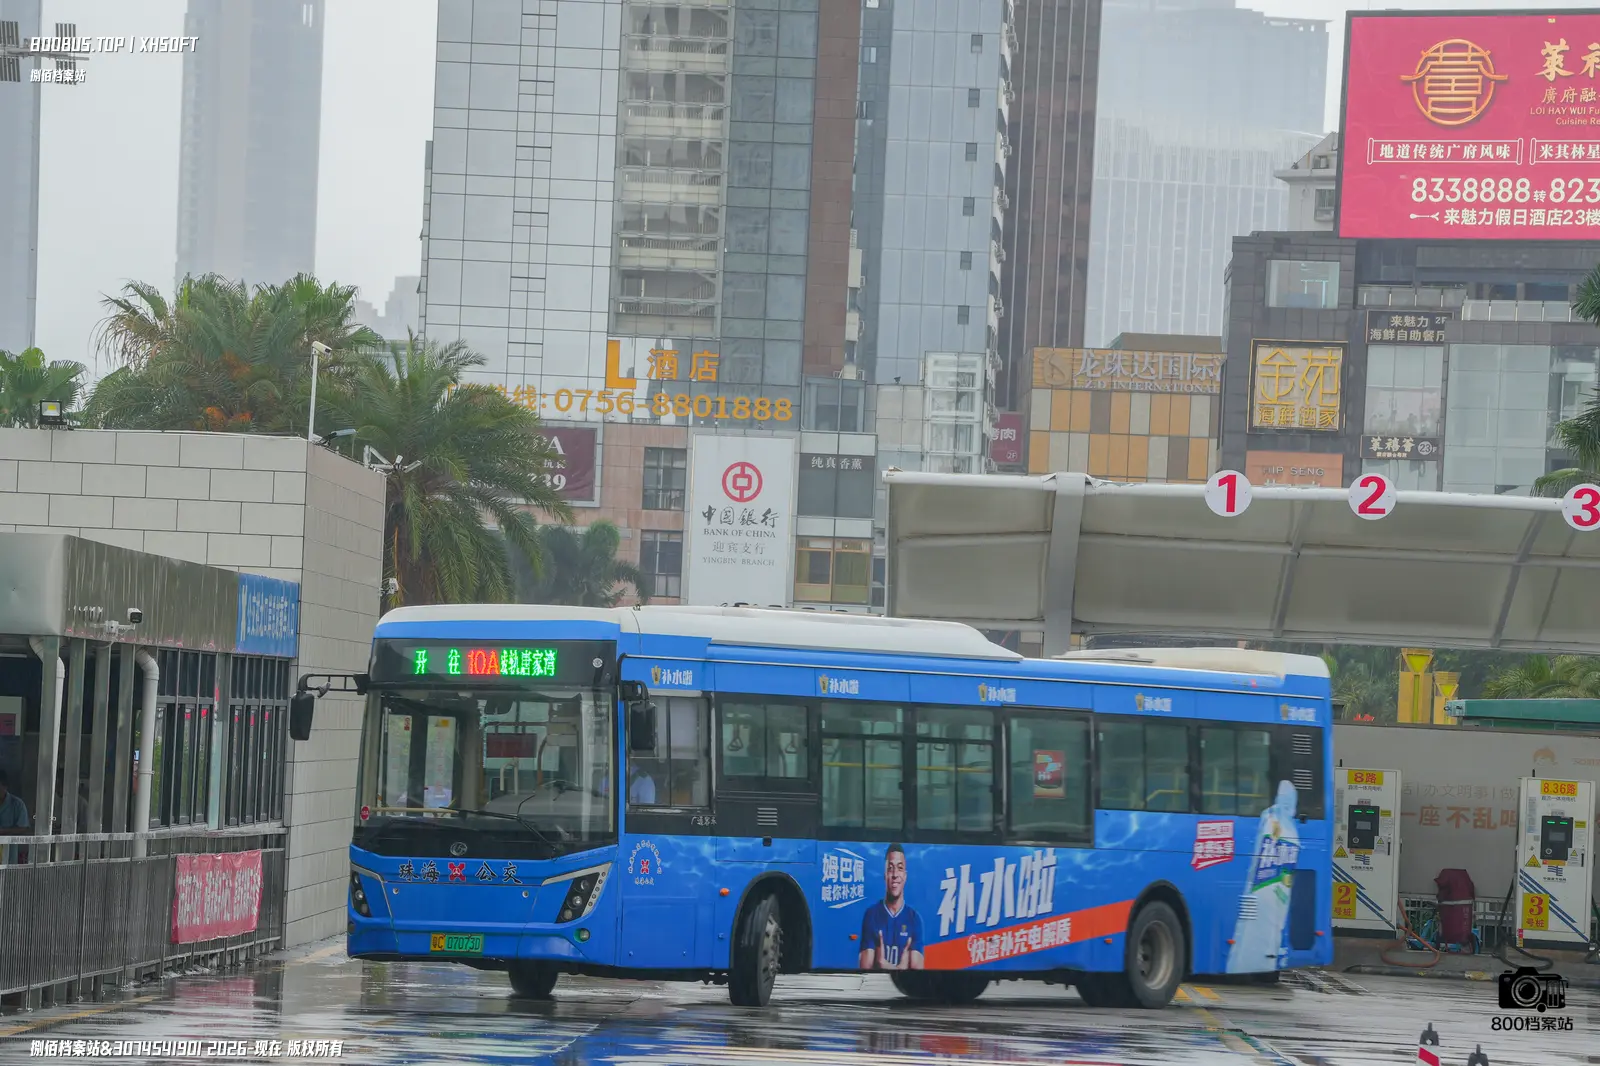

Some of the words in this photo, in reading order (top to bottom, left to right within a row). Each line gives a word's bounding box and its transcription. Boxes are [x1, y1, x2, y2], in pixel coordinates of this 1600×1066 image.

[1542, 86, 1600, 105] 廣府融
[1548, 107, 1567, 115] HAY
[1569, 107, 1586, 115] WUI
[1556, 117, 1587, 126] Cuisine
[1379, 144, 1511, 160] 地道传统广府风味
[1443, 208, 1600, 226] 来魅力假日酒店23楼
[1390, 315, 1429, 327] 来魅力
[1370, 329, 1445, 342] 海鲜自助餐厅
[646, 348, 719, 382] 酒店
[1290, 467, 1324, 476] SENG
[1218, 474, 1237, 513] 1
[1358, 476, 1386, 515] 2
[1572, 488, 1600, 527] 3
[704, 528, 729, 536] BANK
[731, 529, 743, 537] OF
[745, 529, 776, 538] CHINA
[712, 541, 766, 555] 迎宾支行
[702, 556, 736, 564] YINGBIN
[741, 558, 775, 566] BRANCH
[467, 649, 500, 675] 10A
[662, 669, 692, 685] 补水啦
[1354, 772, 1376, 783] 8路
[399, 860, 440, 882] 珠海
[475, 861, 523, 884] 公交
[821, 853, 865, 883] 姆巴佩
[821, 884, 865, 902] 喊你补水啦
[937, 847, 1057, 937] 补水啦
[1338, 885, 1351, 905] 2
[1529, 896, 1544, 916] 3
[971, 918, 1071, 963] 快速补充电解质
